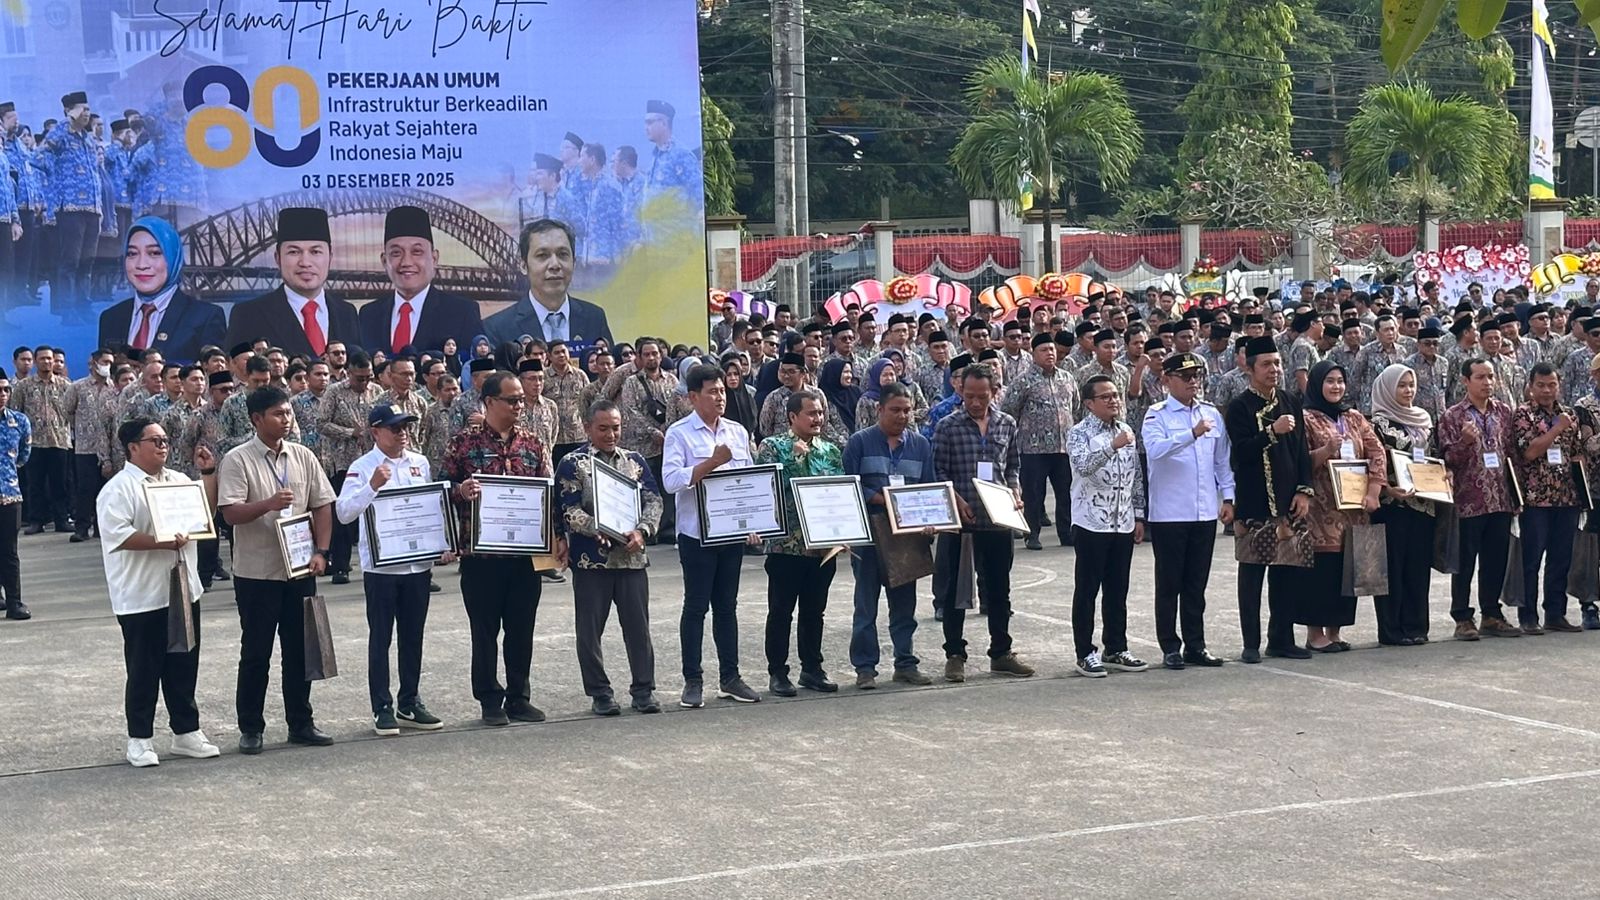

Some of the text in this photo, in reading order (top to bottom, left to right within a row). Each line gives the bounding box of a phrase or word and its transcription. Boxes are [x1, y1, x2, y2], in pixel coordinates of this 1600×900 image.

[154, 0, 548, 60] Selamat Hari Bakti
[327, 71, 500, 89] PEKERJAAN UMUM
[328, 95, 548, 113] Infrastruktur Berkeadilan
[183, 65, 320, 168] 80
[329, 120, 478, 140] Rakyat Sejahtera
[330, 143, 462, 162] Indonesia Maju
[302, 172, 455, 189] 03 DESEMBER 2025
